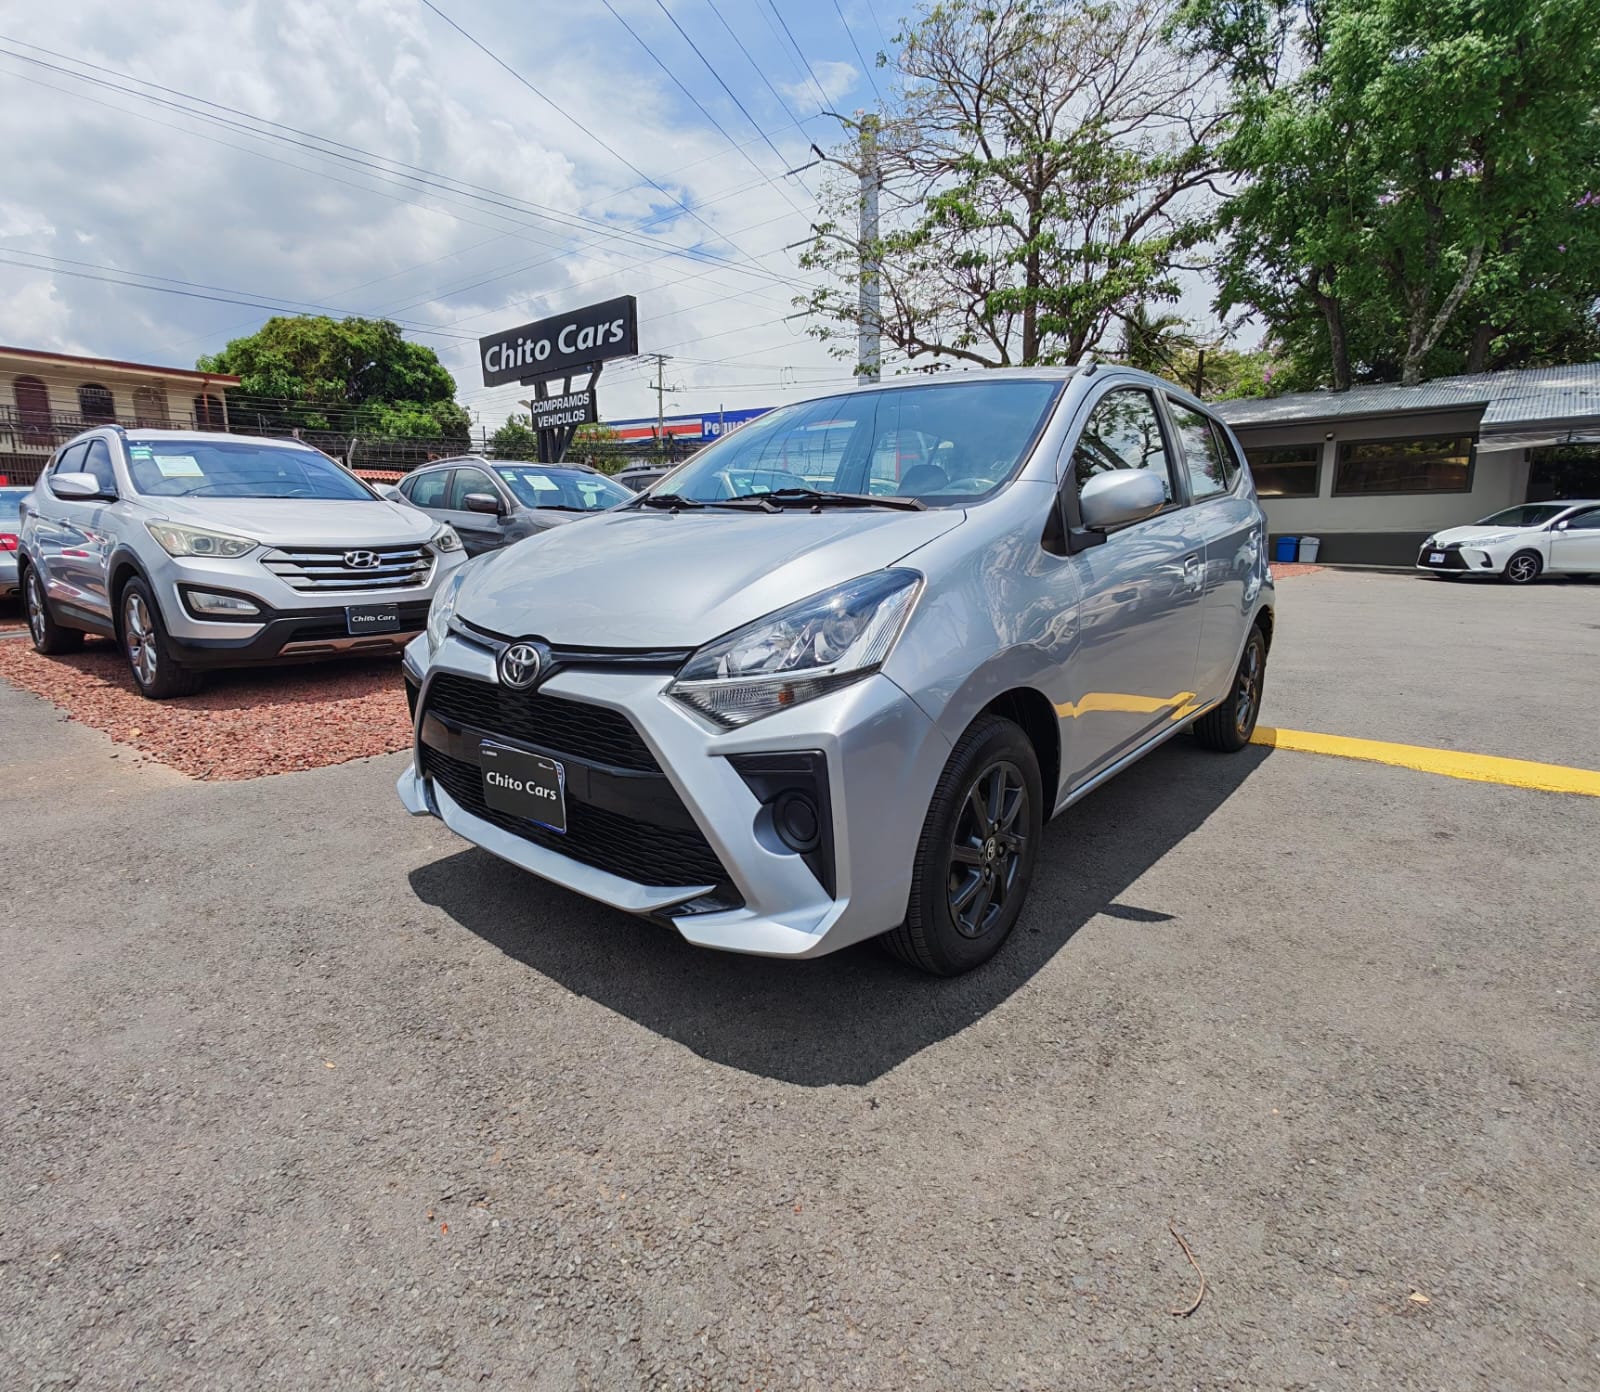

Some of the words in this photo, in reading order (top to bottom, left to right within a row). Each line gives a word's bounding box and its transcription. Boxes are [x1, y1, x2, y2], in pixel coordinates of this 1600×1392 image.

[485, 338, 551, 373] Chito
[558, 318, 624, 354] Cars
[533, 392, 590, 414] COMPRAMOS
[538, 409, 585, 428] VEHICULOS
[352, 615, 376, 623] Chito
[486, 771, 523, 791] Chito
[525, 781, 557, 800] Cars
